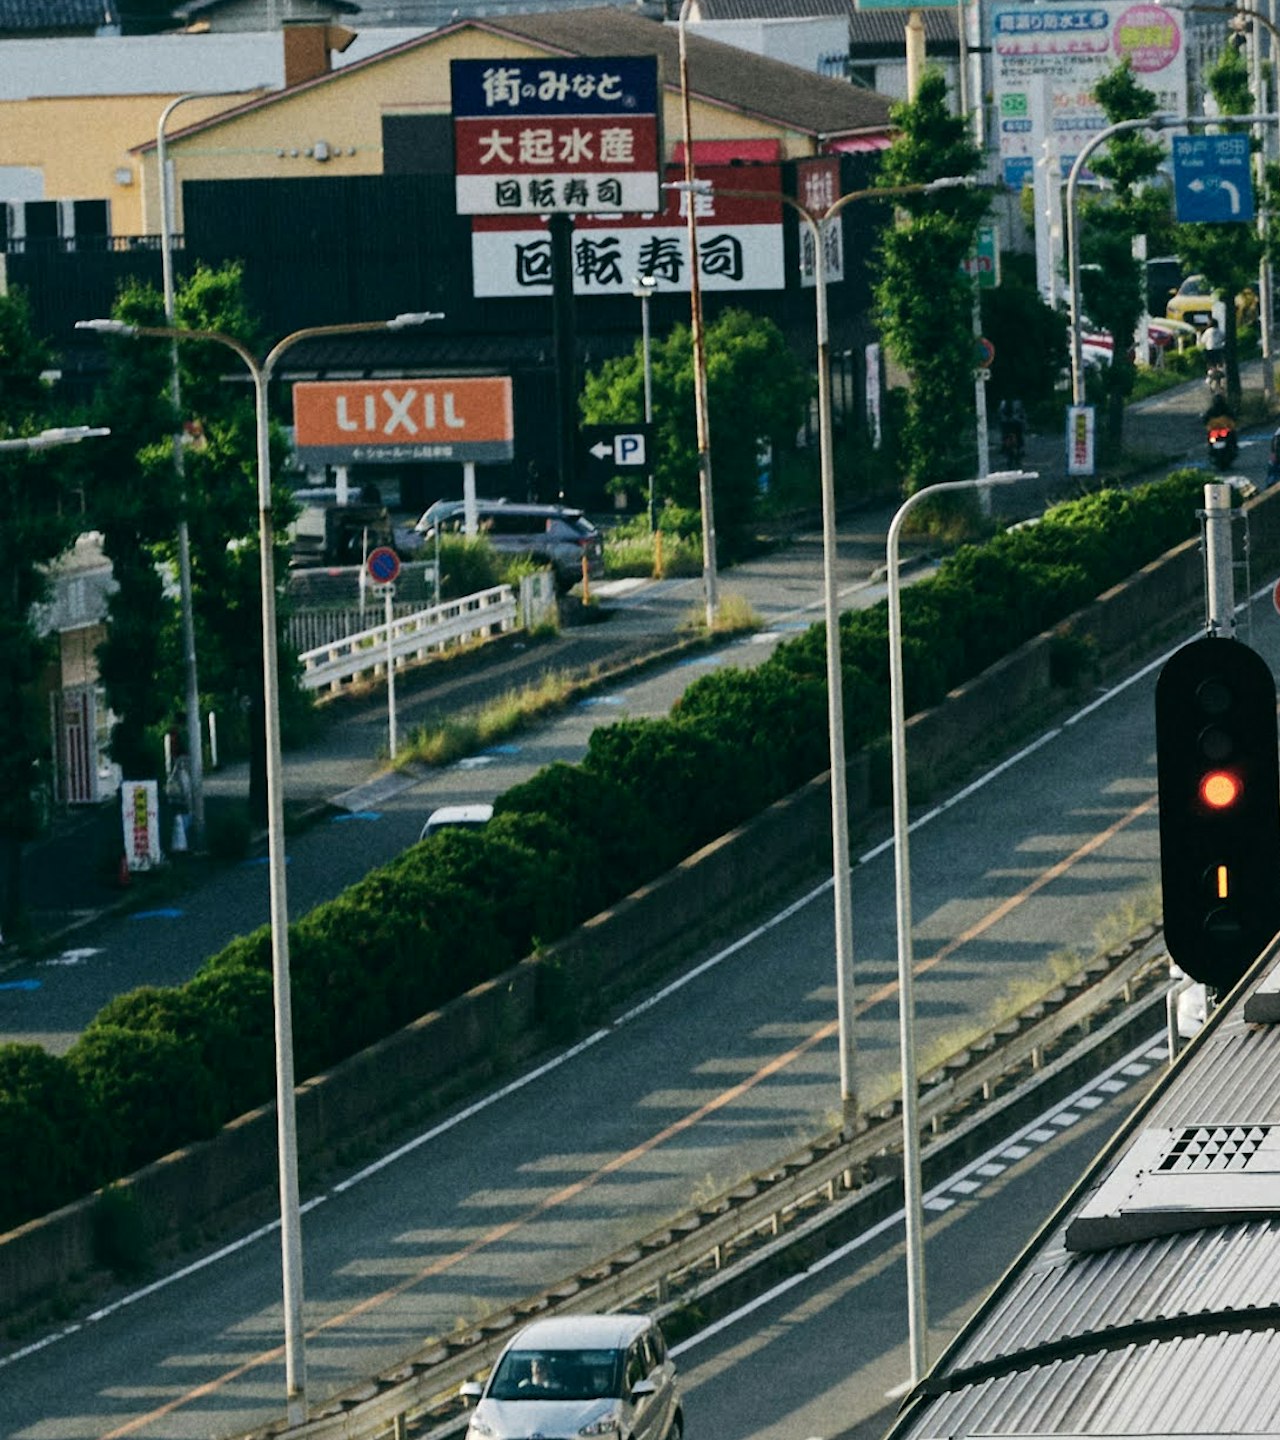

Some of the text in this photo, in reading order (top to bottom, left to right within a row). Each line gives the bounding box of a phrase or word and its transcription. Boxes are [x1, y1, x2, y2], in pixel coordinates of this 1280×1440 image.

[482, 67, 624, 108] 街のみなと
[478, 127, 635, 166] 大起水産
[495, 177, 624, 209] 回転寿司
[515, 233, 744, 286] 回転寿司
[336, 388, 466, 436] LIXIL
[621, 438, 639, 461] P
